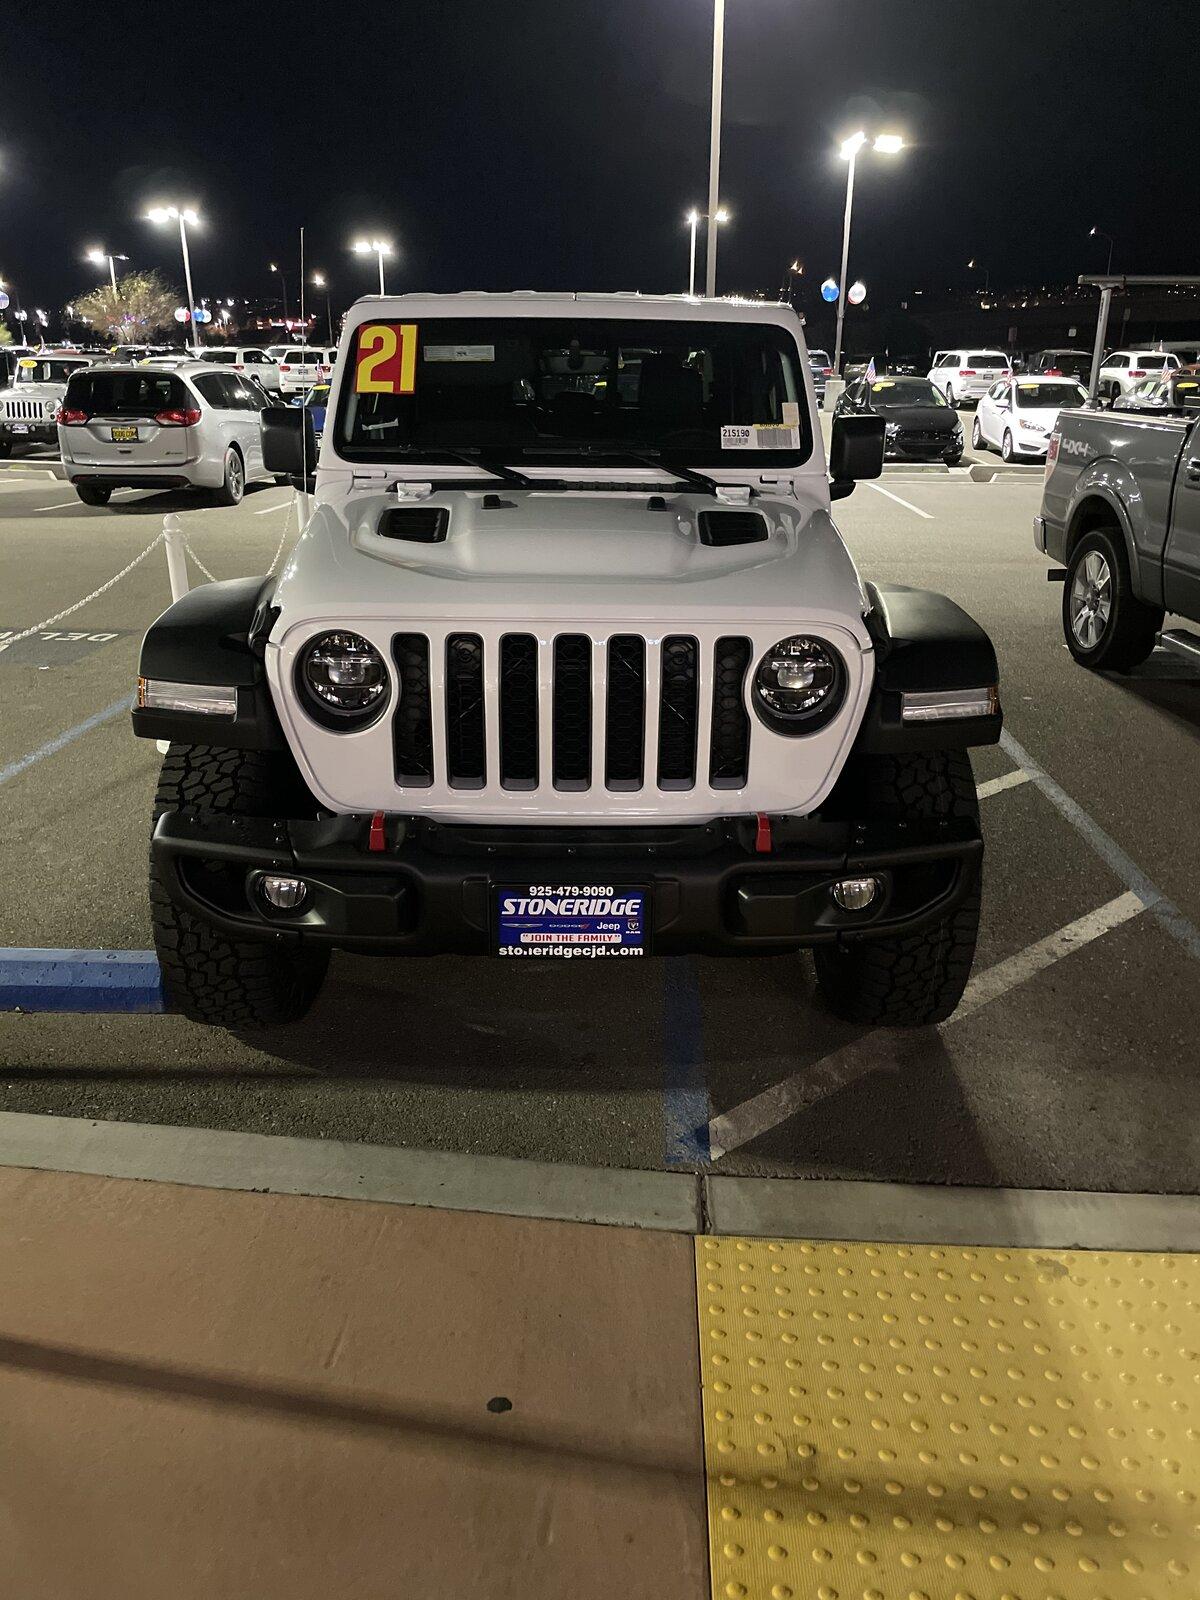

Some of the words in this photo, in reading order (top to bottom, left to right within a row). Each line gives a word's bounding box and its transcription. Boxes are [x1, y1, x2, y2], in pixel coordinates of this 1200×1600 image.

[356, 324, 417, 393] 21
[722, 429, 750, 438] 21S190
[529, 886, 614, 897] 925-479-9090
[501, 898, 642, 916] STONERIDGE
[596, 921, 621, 931] Jeep
[556, 934, 575, 943] THE
